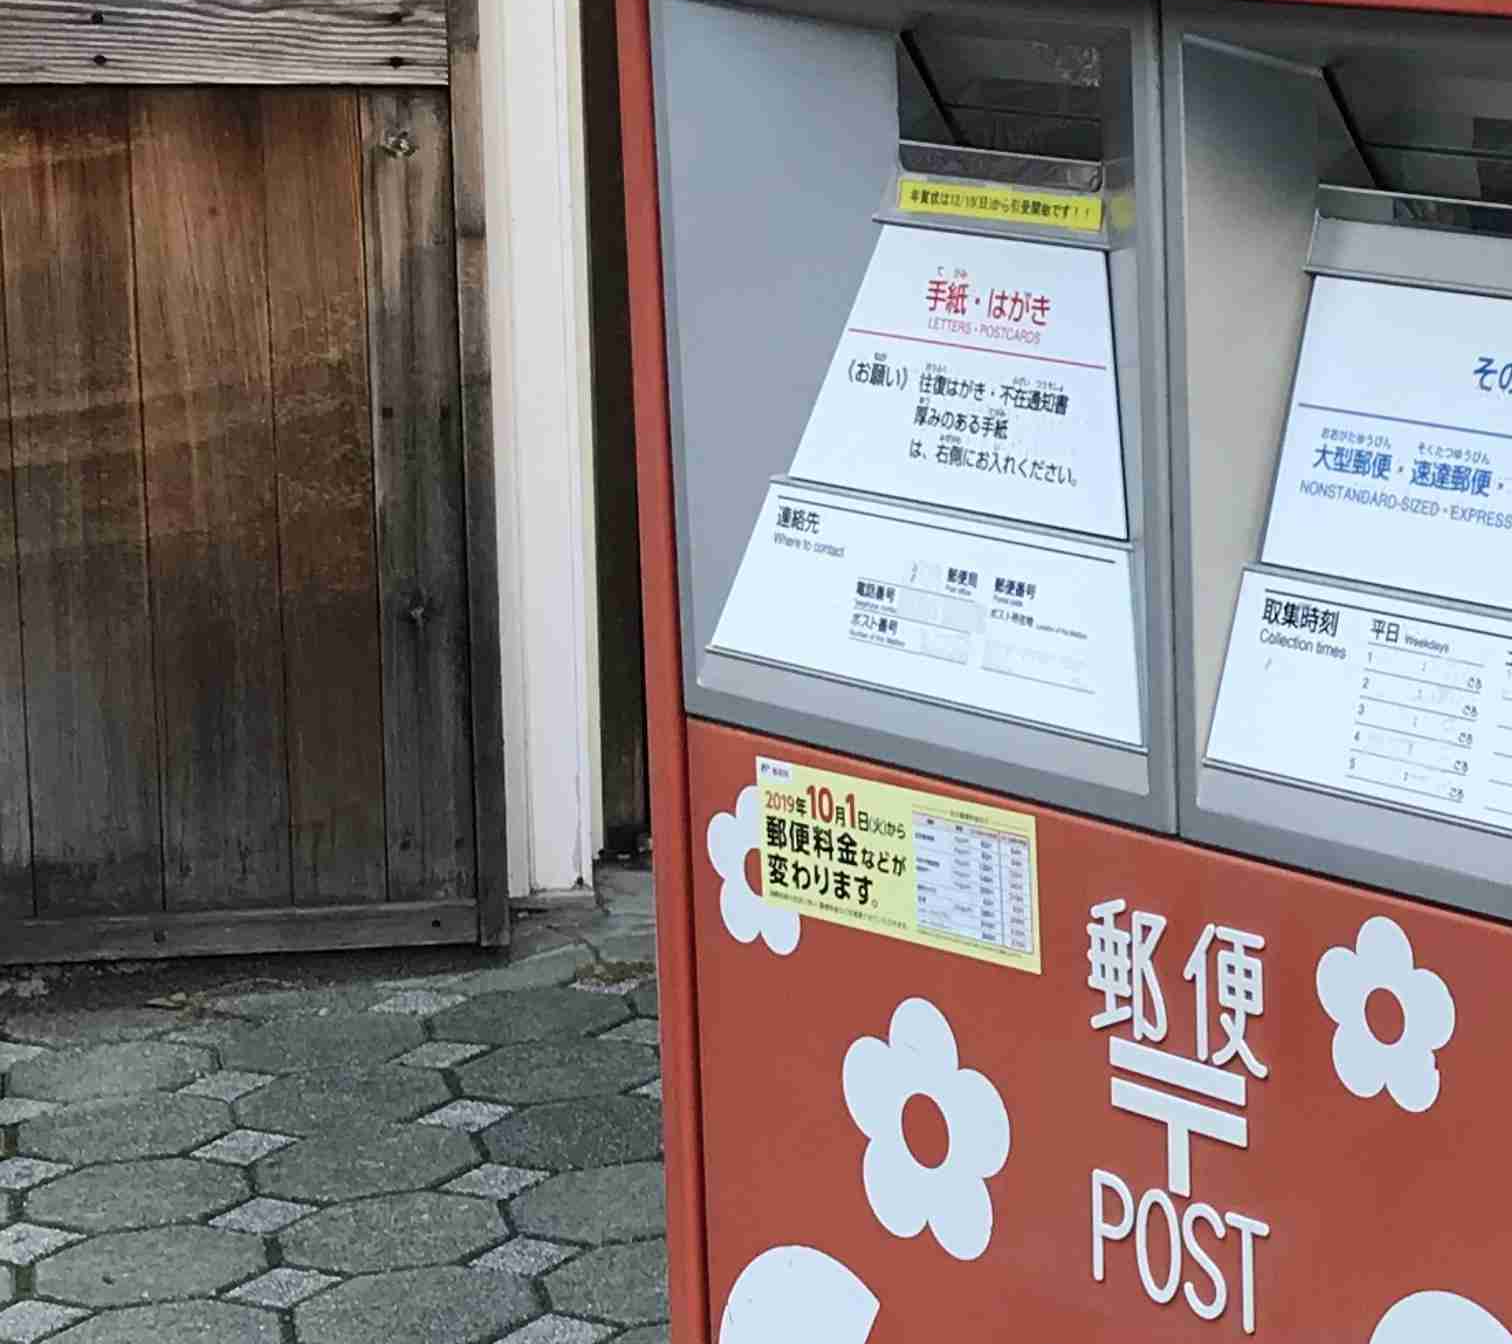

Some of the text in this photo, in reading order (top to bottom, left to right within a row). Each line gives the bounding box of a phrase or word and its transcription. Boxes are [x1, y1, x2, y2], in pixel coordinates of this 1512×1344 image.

[926, 279, 1051, 326] 手紙・はがき
[913, 405, 1009, 440] 厚みのある手紙
[776, 505, 820, 535] 連絡先
[1299, 479, 1440, 517] NONSTANDARD-SIZED
[1450, 505, 1512, 530] EXPRESS
[1261, 597, 1340, 638] 取集時刻
[1371, 617, 1400, 644] 平日
[1259, 627, 1347, 659] Collection times
[766, 815, 907, 877] 郵便料金などが
[767, 853, 879, 909] 変わります。
[1086, 897, 1270, 1079] 郵便
[1091, 1167, 1270, 1336] POST
